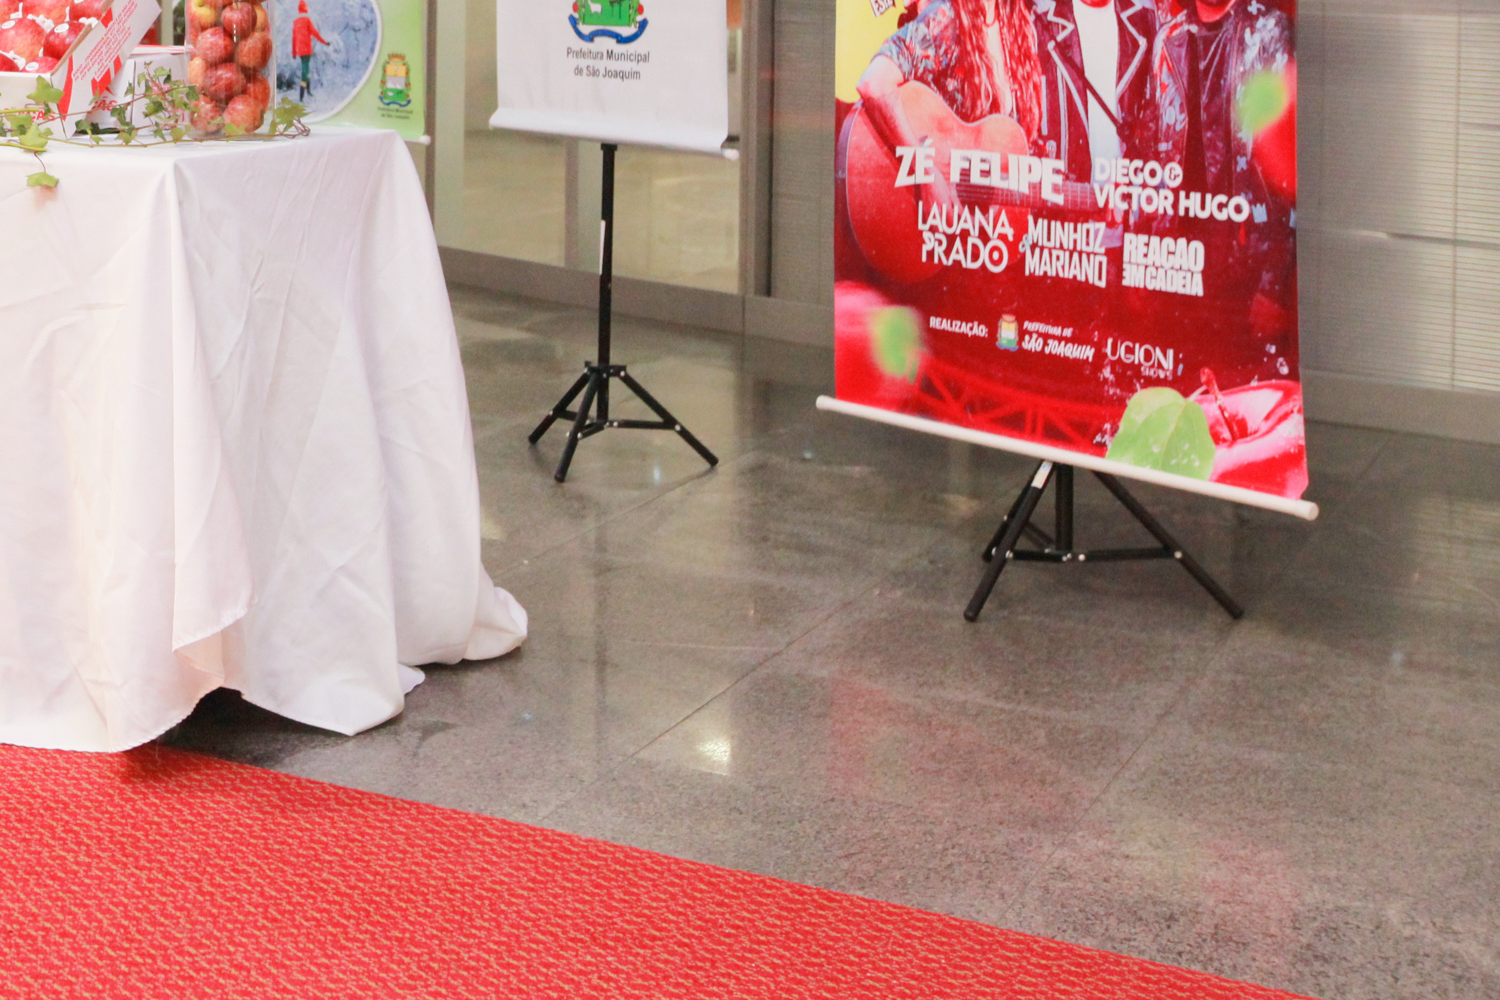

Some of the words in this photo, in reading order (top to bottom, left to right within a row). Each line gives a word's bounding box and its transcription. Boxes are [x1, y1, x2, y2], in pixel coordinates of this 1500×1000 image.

[566, 47, 604, 61] Prefeitura
[606, 50, 650, 64] Municipal
[574, 66, 584, 77] de
[585, 65, 600, 78] São
[602, 67, 641, 82] Joaquim
[894, 138, 936, 188] ZÉ
[950, 149, 1065, 206] FELIPE
[1094, 157, 1163, 187] DIEGO
[1093, 182, 1174, 216] VICTOR
[1178, 190, 1250, 223] HUGO
[918, 200, 1014, 242] LAUANA
[1028, 213, 1107, 254] MUNHOZ
[921, 230, 1009, 274] PRADO
[1025, 246, 1108, 288] MARIANO
[929, 315, 988, 338] REALIZAÇÃO:
[1022, 320, 1062, 337] PREFEITURA
[1062, 327, 1073, 338] DE
[1021, 332, 1043, 353] SÃO
[1044, 338, 1096, 363] JOAQUIM
[1106, 337, 1175, 371] UGIONI
